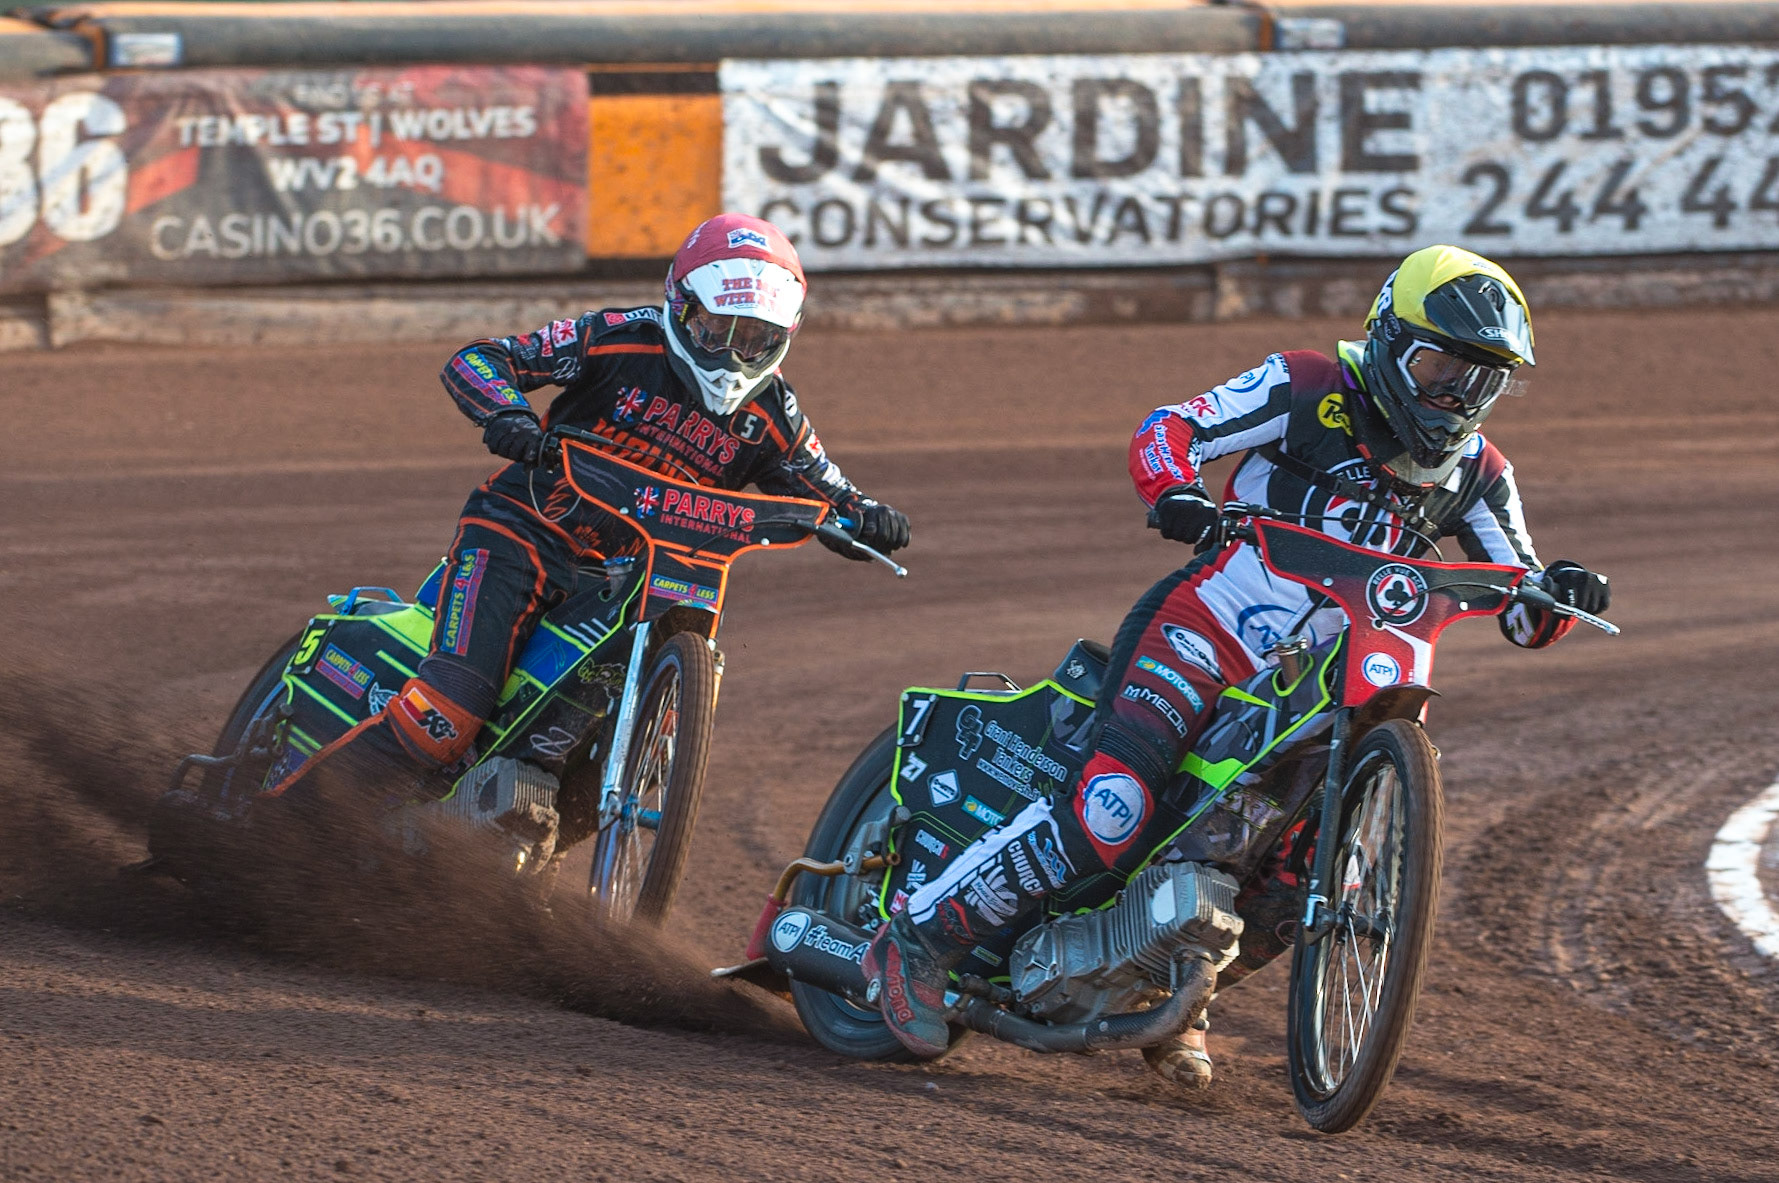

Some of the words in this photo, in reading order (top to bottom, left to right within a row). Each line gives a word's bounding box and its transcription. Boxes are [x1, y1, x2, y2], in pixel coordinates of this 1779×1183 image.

[1511, 65, 1779, 142] 0195
[178, 110, 317, 147] TEMPLE
[323, 109, 363, 144] ST
[390, 106, 538, 142] WOLVES
[757, 73, 1421, 186] JARDINE
[269, 157, 359, 194] WV2
[363, 153, 445, 191] 4AQ
[150, 202, 562, 260] CASINO36.CO.UK
[759, 186, 1420, 249] CONSERVATORIES
[713, 291, 756, 308] WITH
[722, 277, 753, 292] THE
[643, 396, 741, 465] PARRYS
[740, 413, 759, 440] 5
[634, 421, 726, 478] INTERNATIONAL
[660, 513, 752, 545] INTERNATIONAL
[662, 488, 757, 533] PARRYS
[652, 576, 689, 594] CARPETS
[687, 582, 698, 598] 4
[696, 587, 718, 601] LESS
[445, 591, 463, 649] CARPETS
[293, 628, 327, 666] 5
[324, 648, 351, 674] CARPETS
[348, 661, 362, 677] 4
[353, 668, 371, 686] LESS
[1368, 662, 1395, 678] ATPI
[904, 699, 931, 736] 7
[984, 719, 1013, 748] Grant
[1007, 734, 1068, 783] Henderson
[991, 746, 1034, 784] Tankers
[975, 804, 1006, 827] MOTO
[1093, 787, 1135, 828] ATPI
[777, 922, 802, 940] ATPI
[803, 924, 872, 965] #teamA
